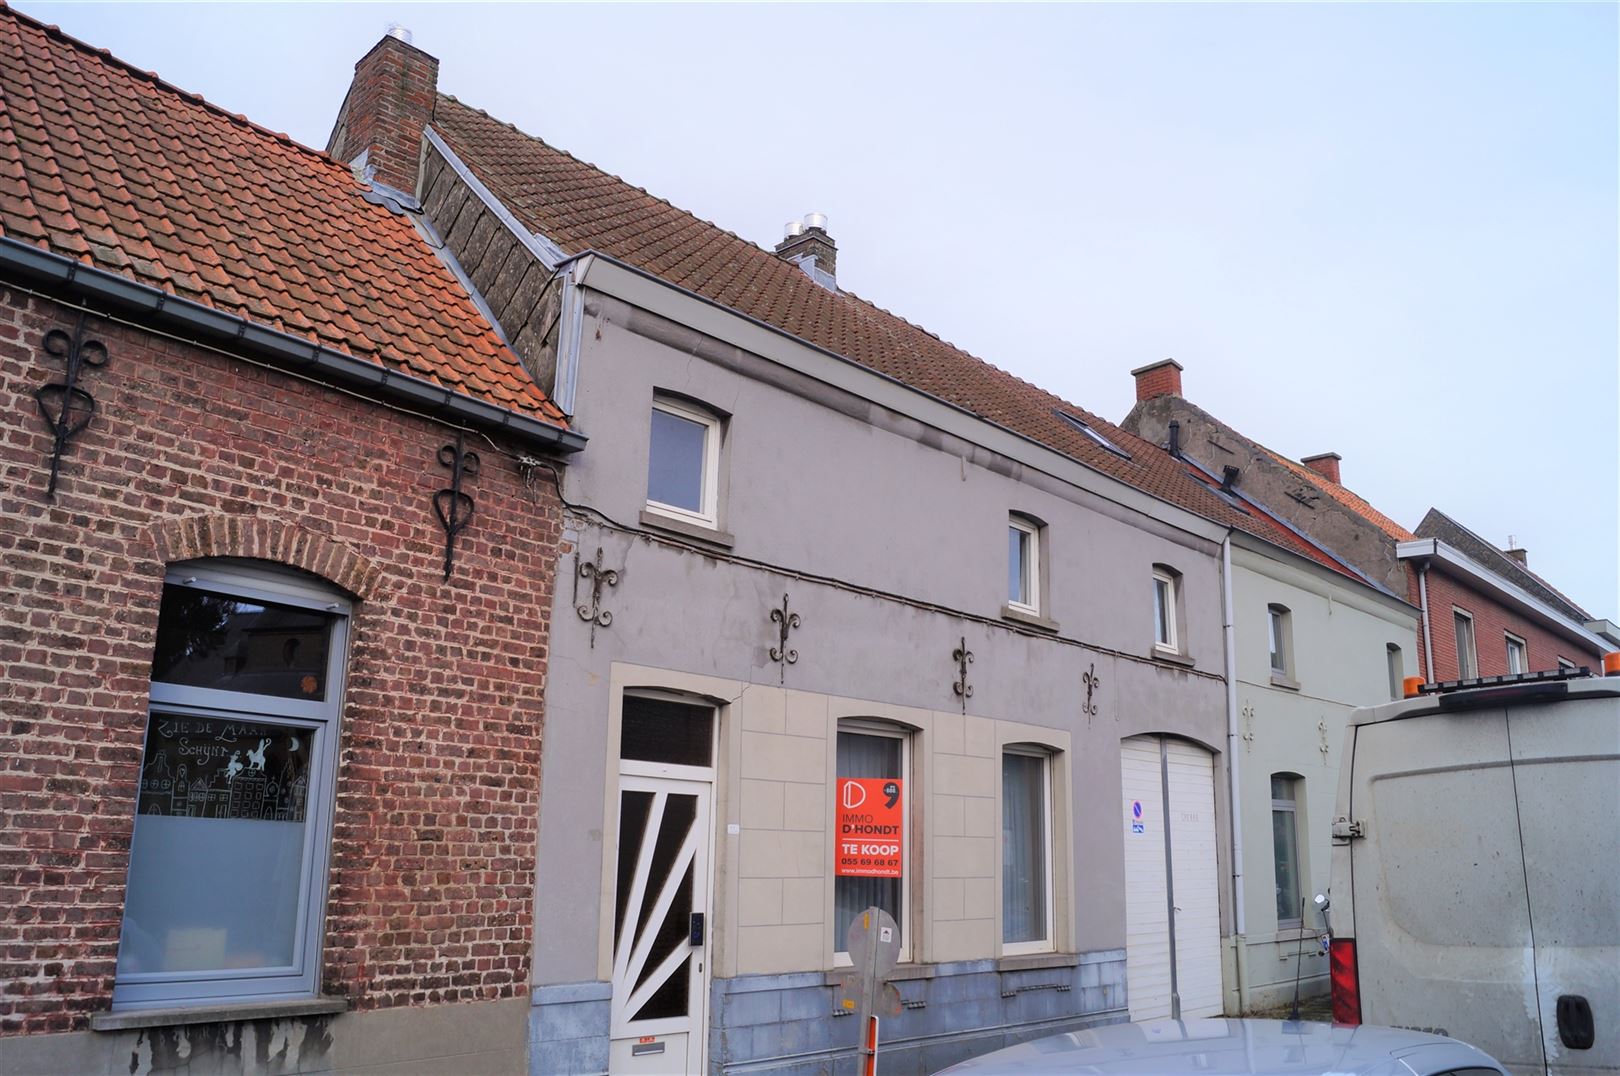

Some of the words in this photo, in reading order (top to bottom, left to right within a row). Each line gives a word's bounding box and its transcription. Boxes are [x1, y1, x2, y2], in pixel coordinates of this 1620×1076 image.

[158, 719, 190, 738] ZIE
[194, 722, 213, 734] DE
[842, 814, 874, 824] IMMO
[842, 824, 899, 835] D'HONDT
[842, 844, 858, 855] TE
[861, 844, 899, 856] KOOP
[841, 858, 858, 866] 055
[860, 858, 872, 866] 69
[874, 858, 885, 866] 68
[887, 858, 898, 867] 67
[841, 868, 899, 876] www.immodhondt.be
